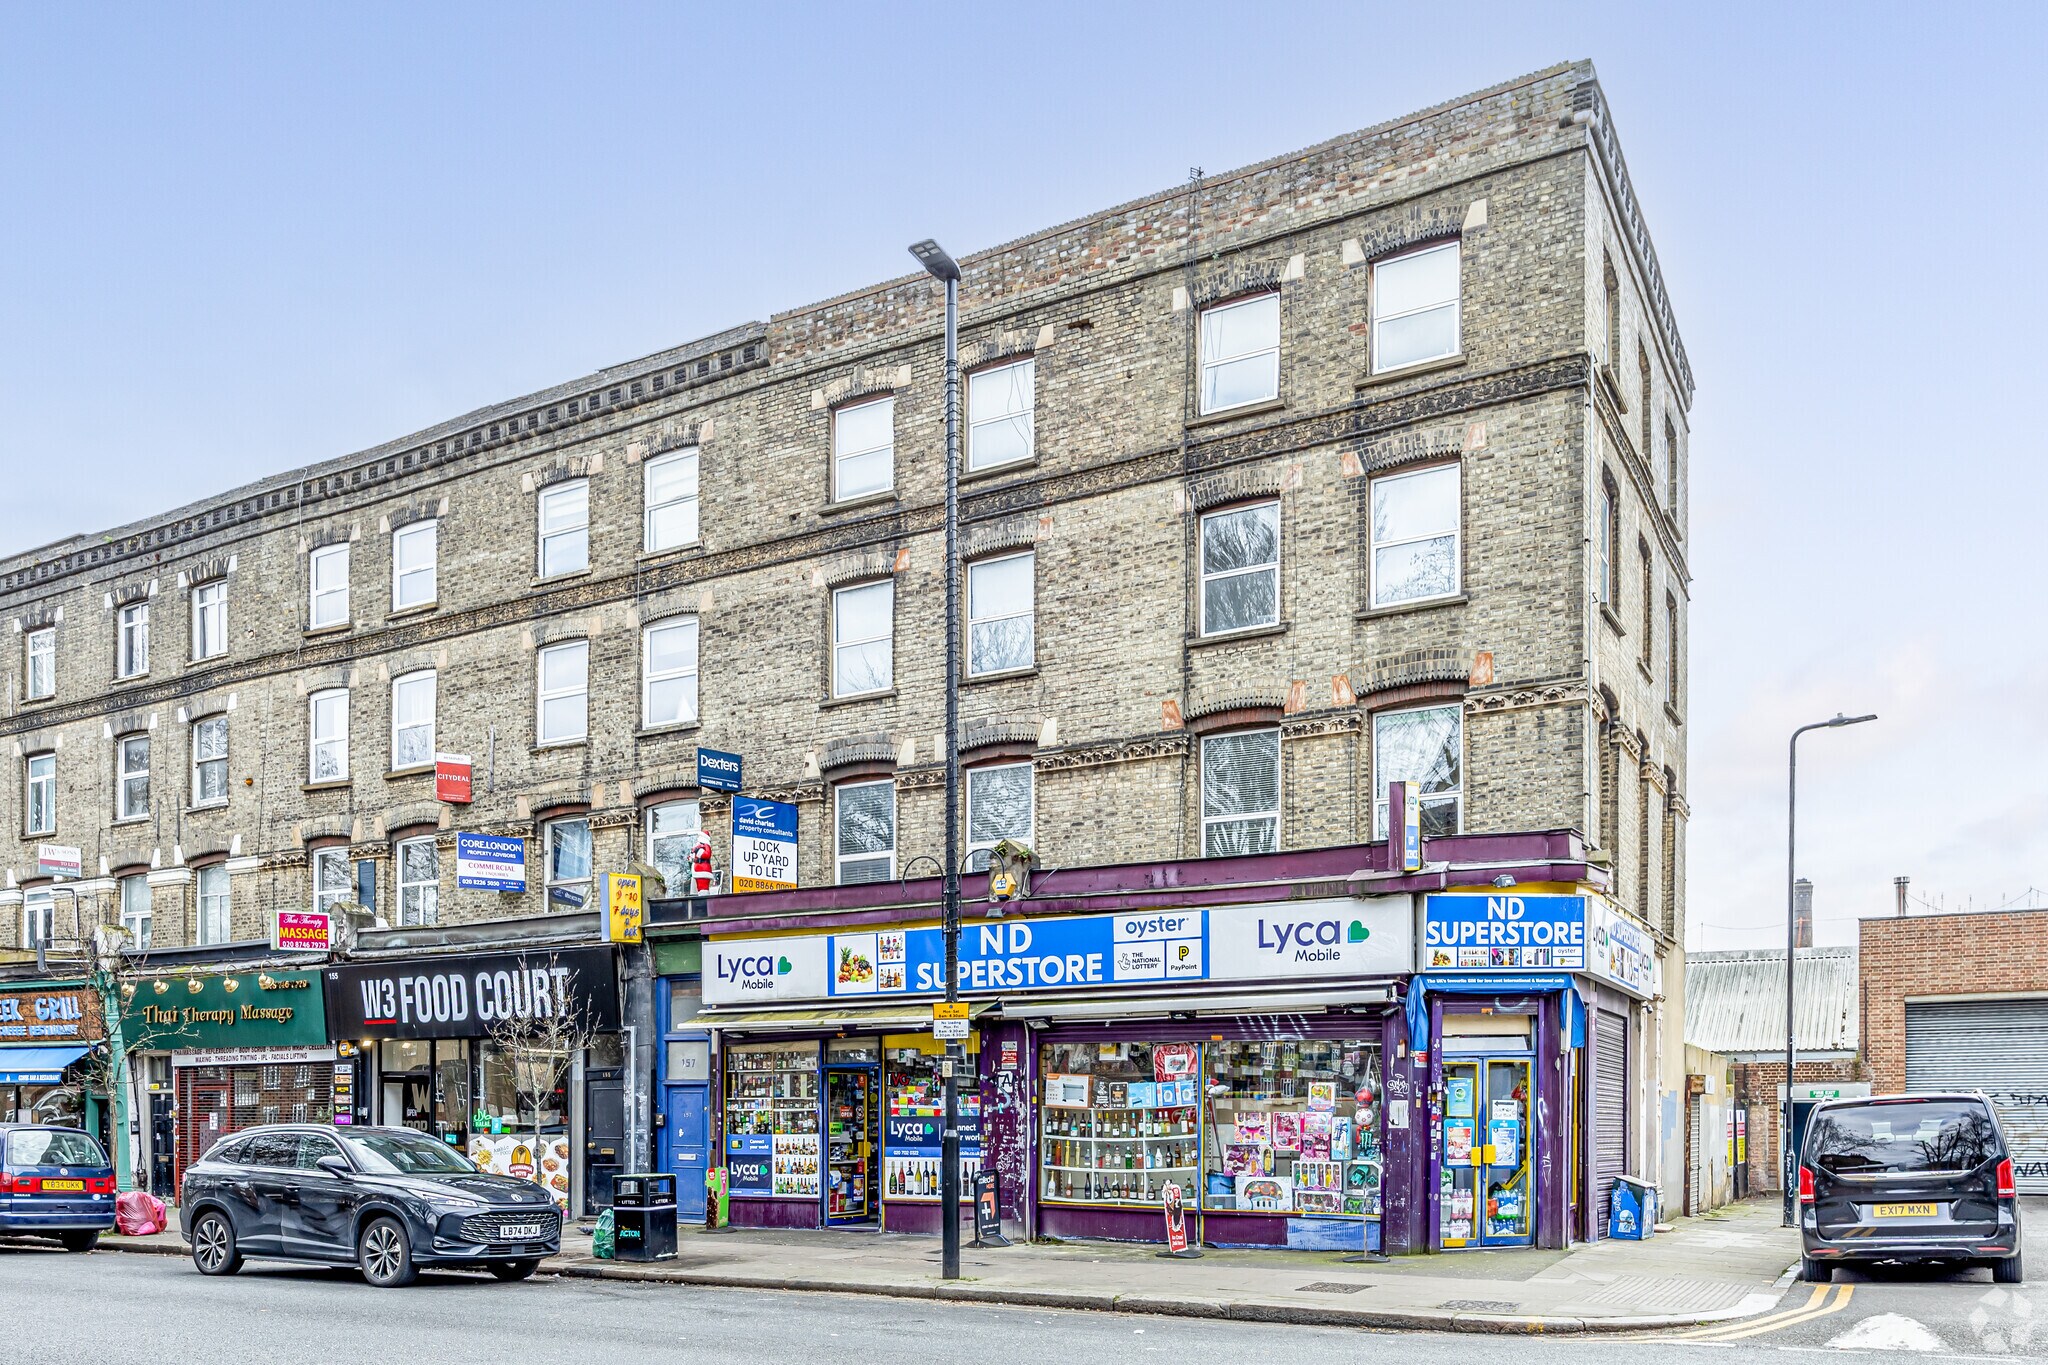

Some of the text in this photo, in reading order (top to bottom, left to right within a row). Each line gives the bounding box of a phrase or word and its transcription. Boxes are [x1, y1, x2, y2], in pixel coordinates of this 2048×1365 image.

[701, 754, 739, 772] Dexters
[438, 773, 470, 782] CITYDEAL
[739, 816, 775, 828] david charles
[739, 824, 793, 837] property consultants
[467, 849, 492, 857] PROPERTY
[752, 840, 780, 854] LOCK
[743, 851, 789, 867] UP YARD
[468, 862, 515, 873] COMMERCIAL
[748, 864, 784, 879] TO LET
[617, 878, 636, 889] open
[738, 879, 774, 891] 020 8866
[1488, 897, 1525, 920] ND
[299, 915, 323, 928] Therapy
[1125, 916, 1185, 938] oyster
[279, 927, 328, 940] MASSAGE
[980, 923, 1033, 956] ND
[1258, 919, 1341, 954] Lyca
[1426, 921, 1583, 945] SUPERSTORE
[295, 941, 310, 949] 8746
[1294, 948, 1341, 962] Mobile
[718, 954, 773, 983] Lyca
[916, 953, 1103, 990] SUPERSTORE
[742, 979, 774, 990] Mobile
[360, 967, 569, 1023] W3 FOOD COURT
[35, 996, 82, 1021] GRILL
[142, 1004, 293, 1025] Thai Therapy Massage
[682, 1059, 696, 1068] 157
[888, 1072, 910, 1086] IVG
[890, 1121, 923, 1137] Lyca
[731, 1162, 759, 1177] Lyca
[1880, 1205, 1930, 1215] EX17 MXN
[503, 1225, 538, 1236] LB74 DKJ
[619, 1230, 640, 1238] ACTON
